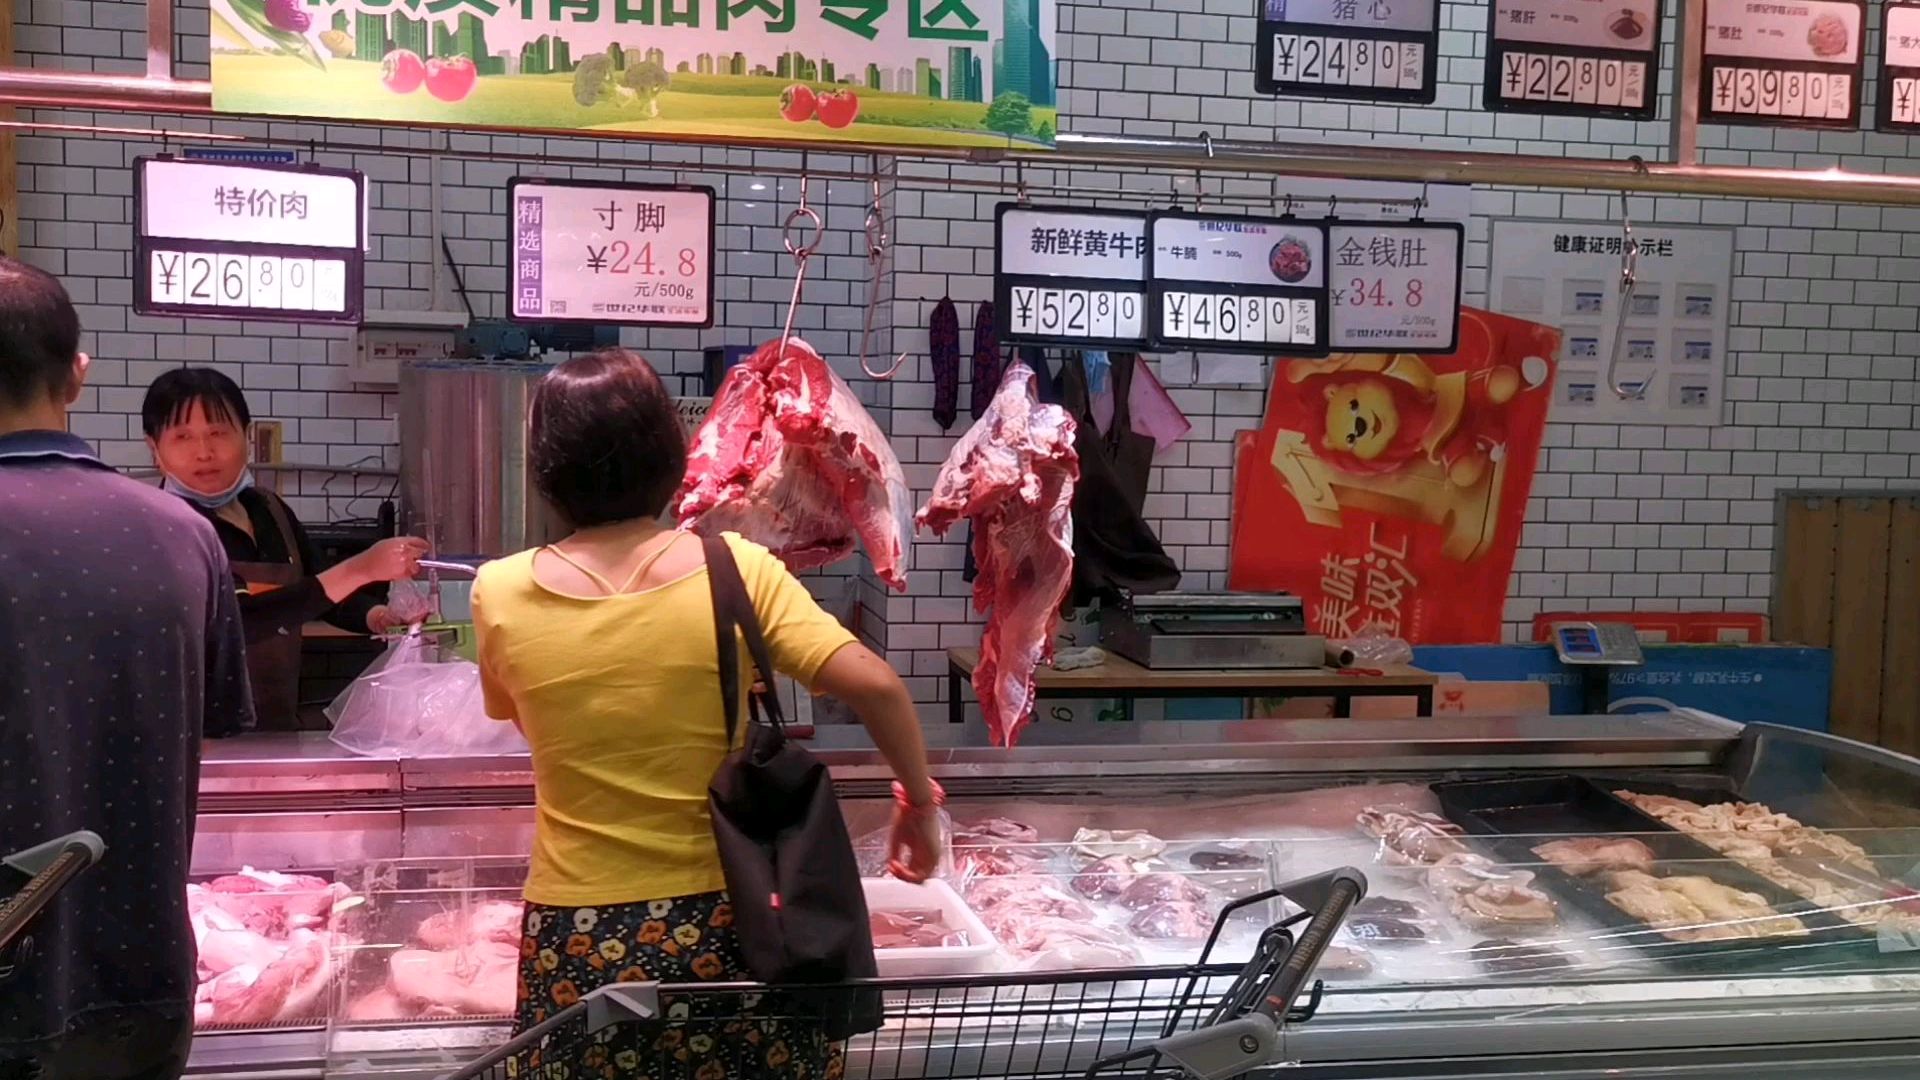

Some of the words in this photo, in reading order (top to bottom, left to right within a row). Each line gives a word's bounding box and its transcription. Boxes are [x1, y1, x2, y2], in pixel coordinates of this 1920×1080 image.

[1277, 37, 1394, 79] ¥24.80
[1506, 55, 1617, 97] ¥22.80
[1716, 70, 1823, 108] ¥39.80
[214, 186, 308, 219] 特价肉
[592, 200, 666, 233] 寸脚
[518, 200, 542, 310] 精选商品
[1336, 236, 1428, 268] 金钱肚
[1553, 234, 1674, 257] 健康证明示栏
[157, 253, 305, 300] ¥26.80
[634, 281, 695, 300] 元/500g
[1331, 278, 1423, 307] ¥34.8
[1015, 289, 1135, 330] ¥52.80
[1167, 294, 1285, 334] ¥46.80
[1312, 552, 1360, 638] 美味
